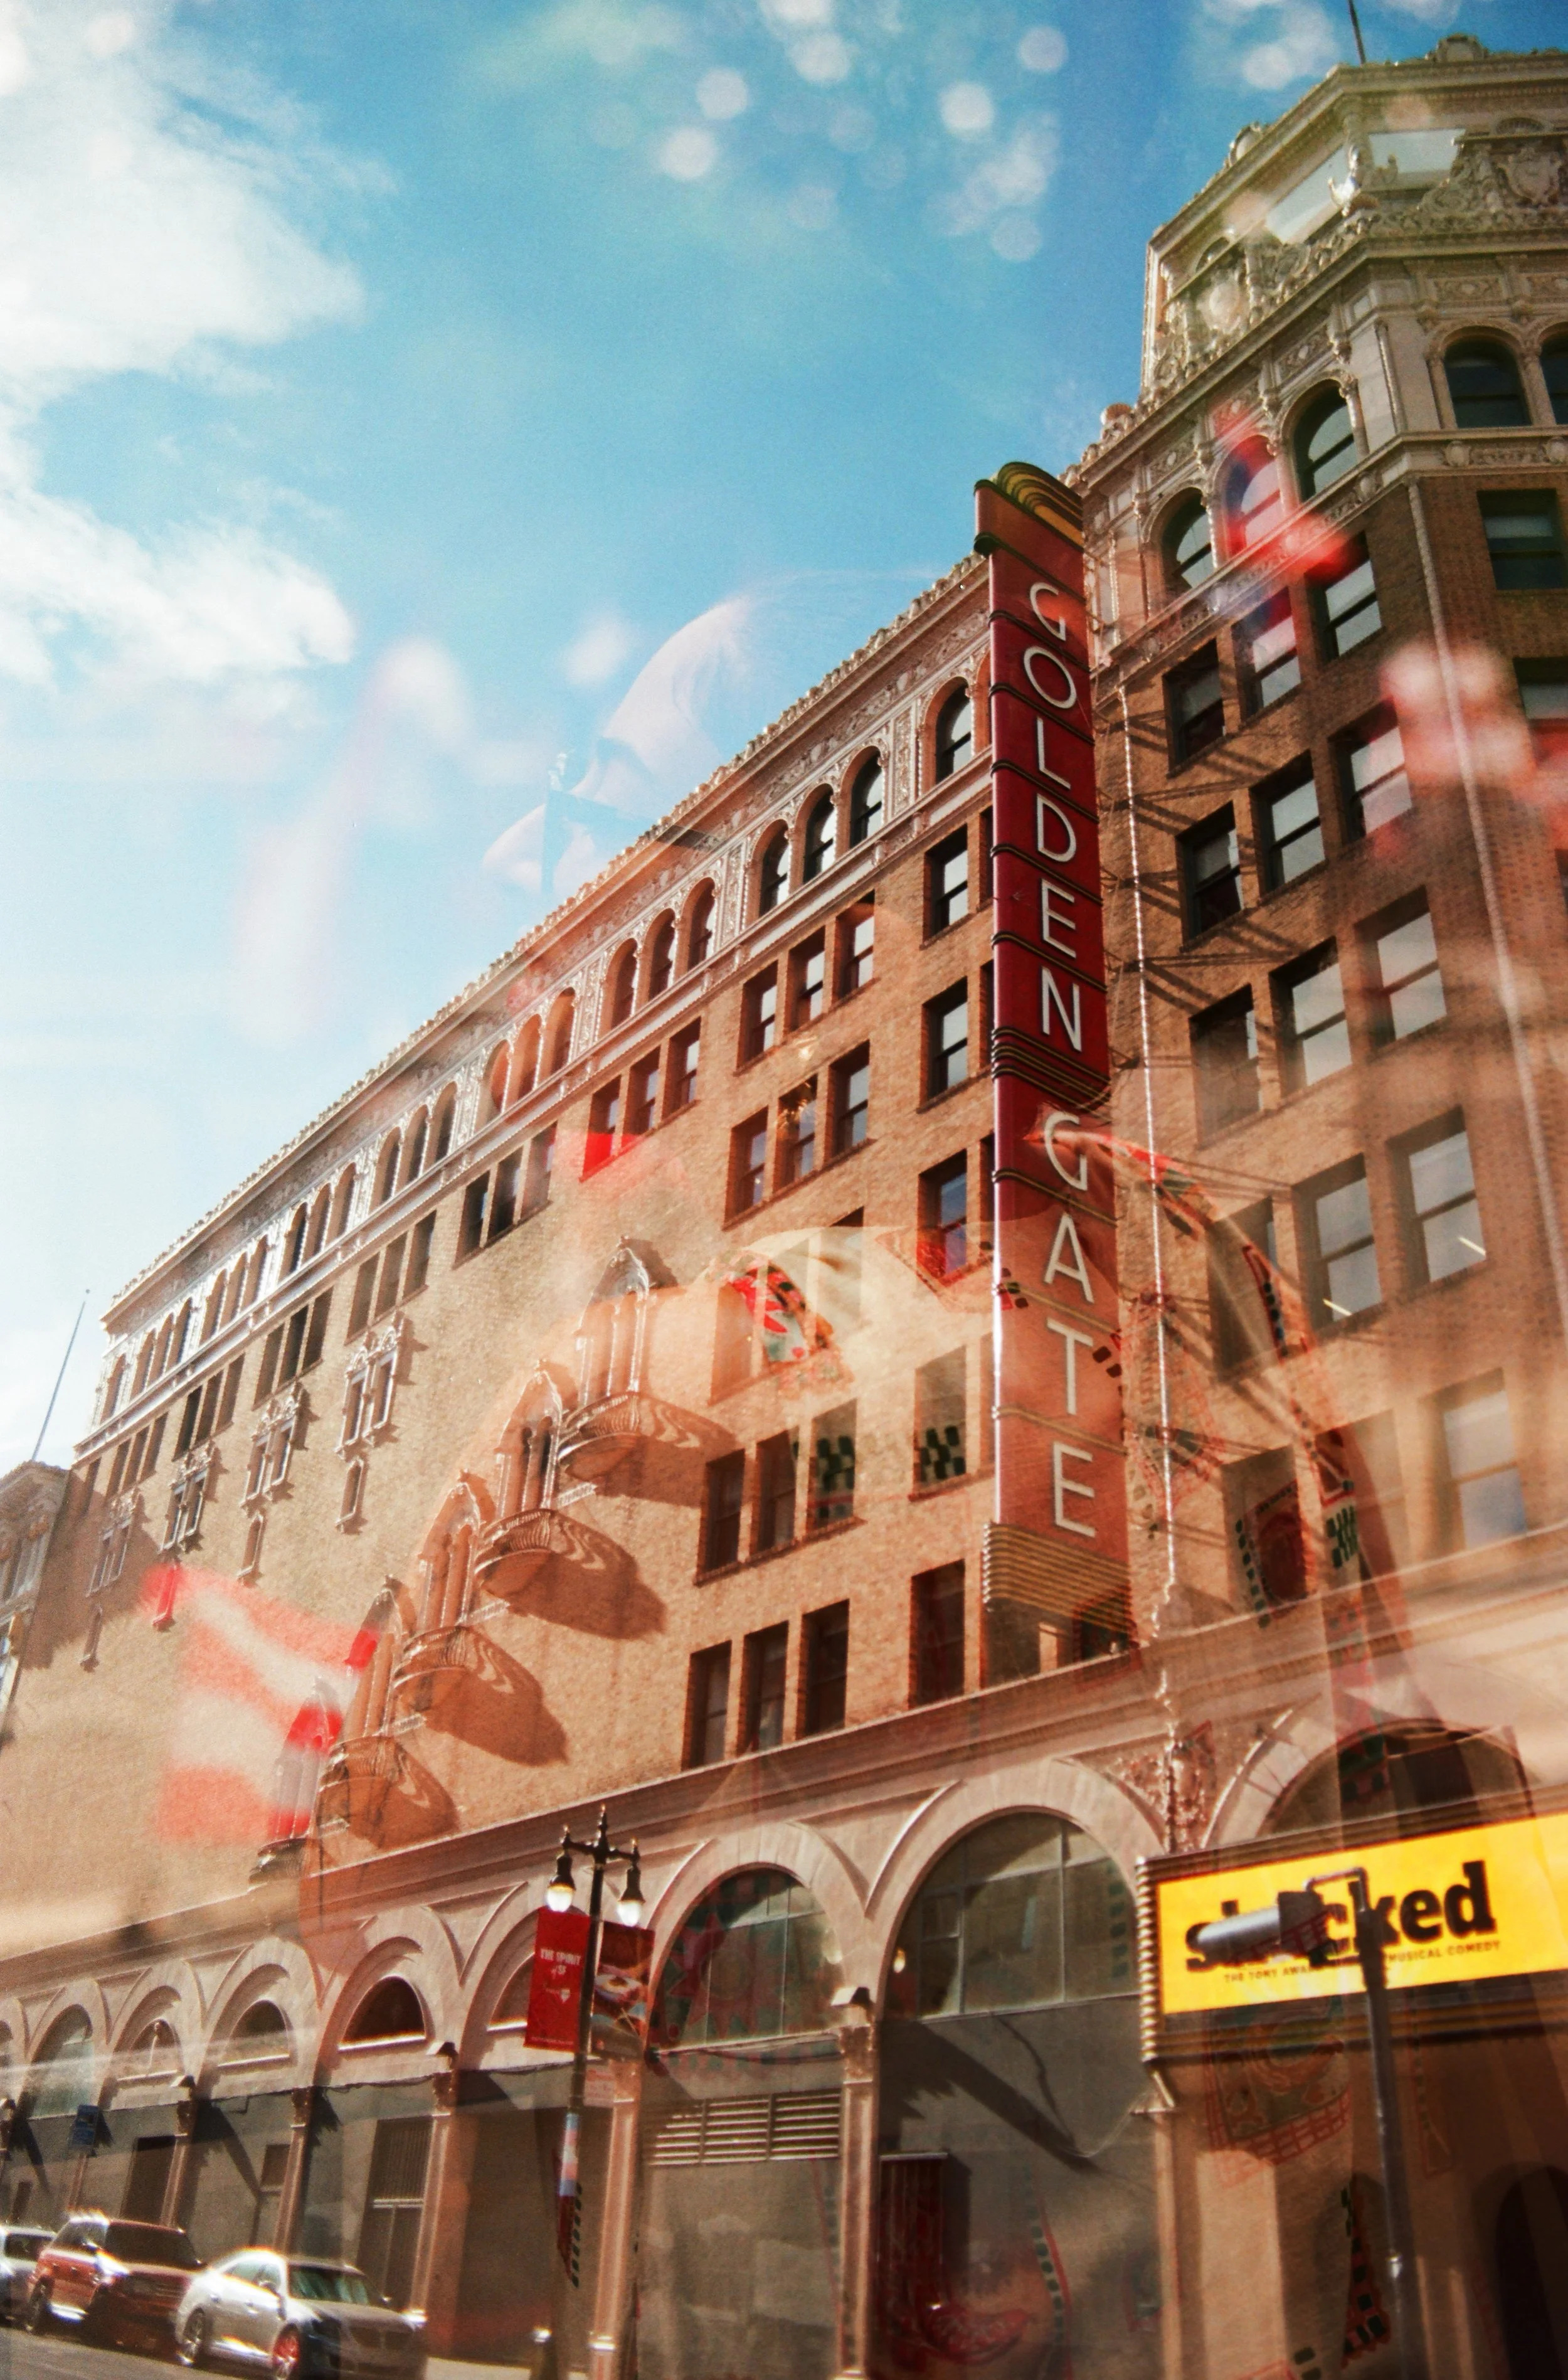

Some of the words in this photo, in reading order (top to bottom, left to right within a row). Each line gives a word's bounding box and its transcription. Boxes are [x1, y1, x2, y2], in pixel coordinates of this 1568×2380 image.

[1023, 581, 1083, 1054] GOLDEN
[1044, 1112, 1096, 1538] GATE
[1224, 1972, 1244, 1983] THE
[1249, 1968, 1278, 1980] TONY
[1388, 1947, 1441, 1962] MUSICAL
[1447, 1940, 1500, 1956] COMEDY
